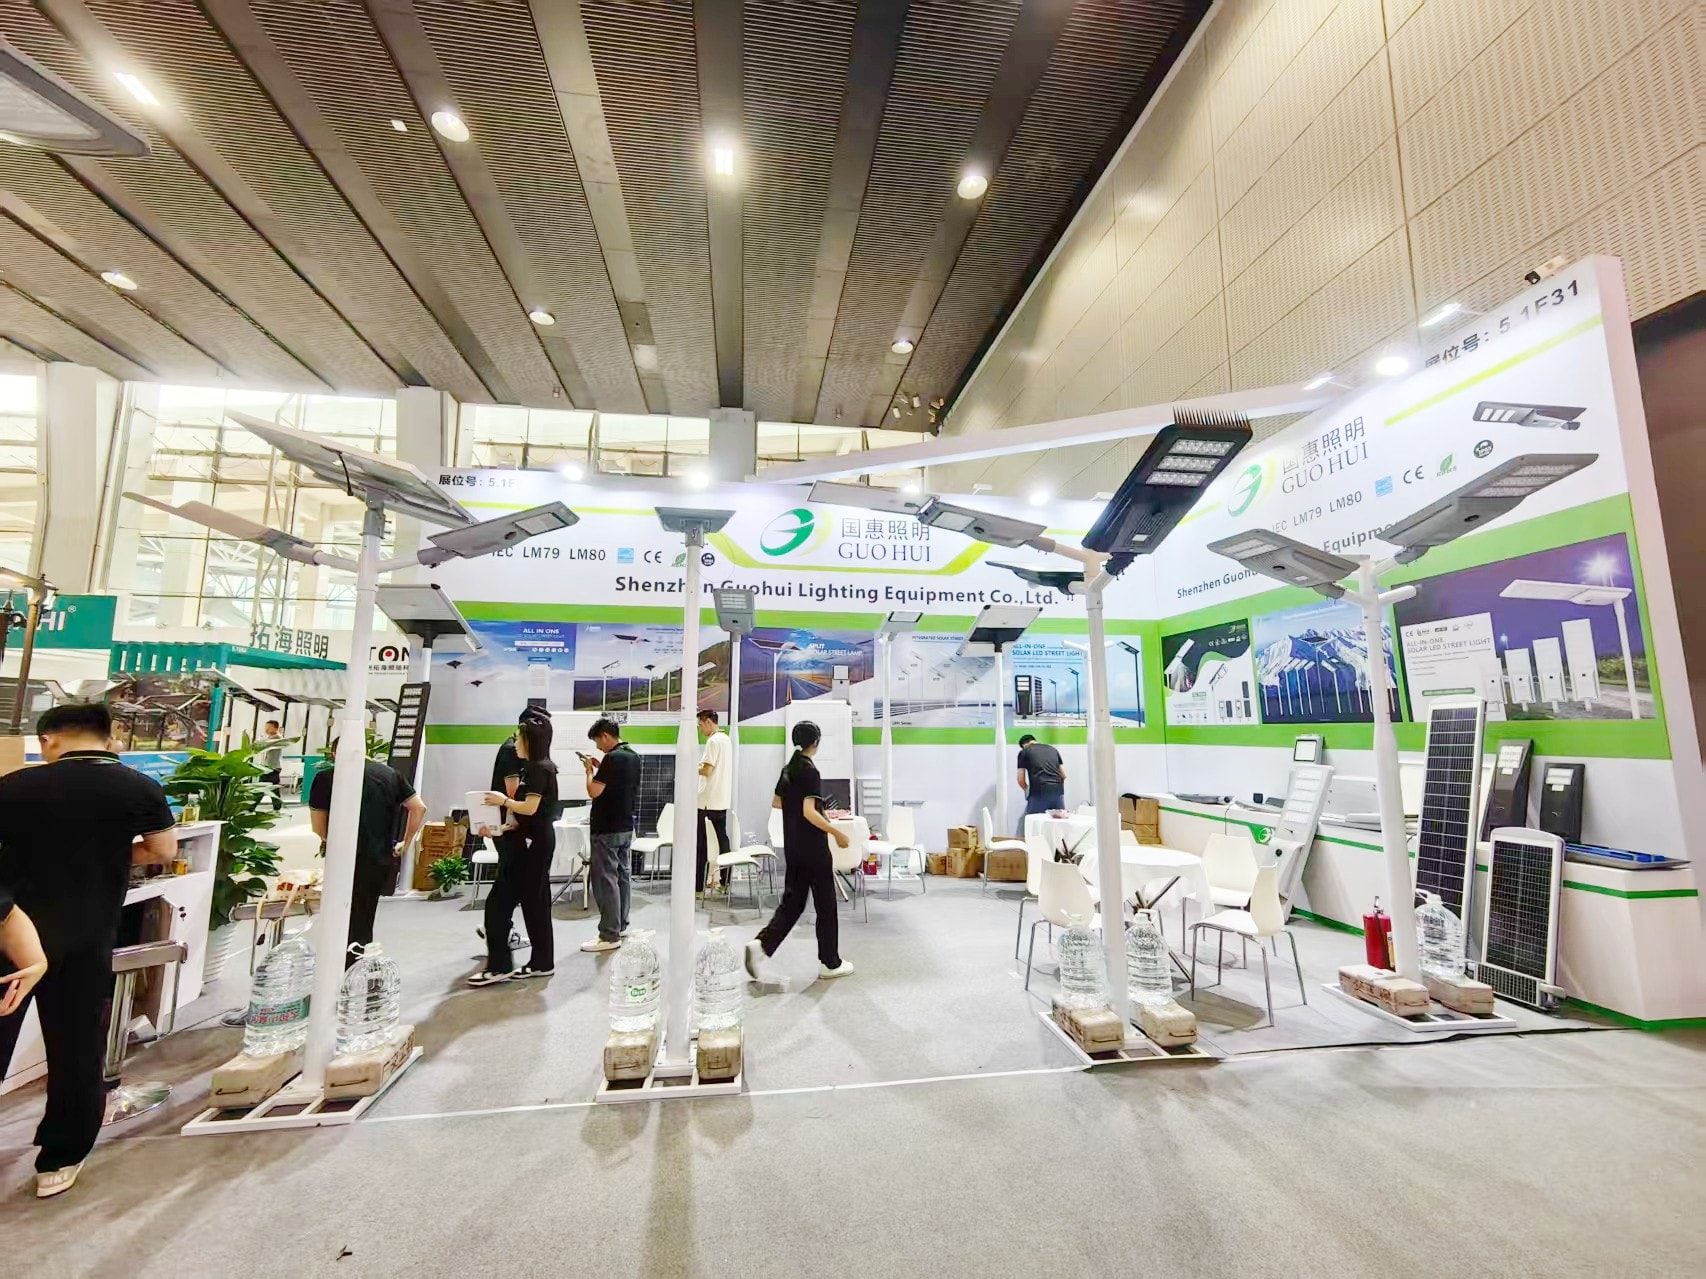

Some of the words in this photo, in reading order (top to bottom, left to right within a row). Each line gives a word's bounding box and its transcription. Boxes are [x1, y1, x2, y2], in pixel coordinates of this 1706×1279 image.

[1281, 463, 1324, 494] GUO
[1328, 441, 1369, 476] HUI
[1272, 519, 1288, 533] IEC
[1293, 507, 1323, 527] LM79
[1329, 490, 1363, 513] LM80
[841, 518, 930, 541] 国惠照明
[522, 546, 561, 559] LM79
[569, 548, 606, 561] LM80
[838, 542, 887, 561] GUO
[893, 544, 932, 562] HUI
[615, 576, 714, 593] Shenzhn
[799, 583, 879, 604] Lighting
[884, 586, 985, 605] Equipment
[1176, 578, 1222, 599] Shenzhen
[249, 619, 330, 660] 拓海照明
[1443, 641, 1467, 650] STREET
